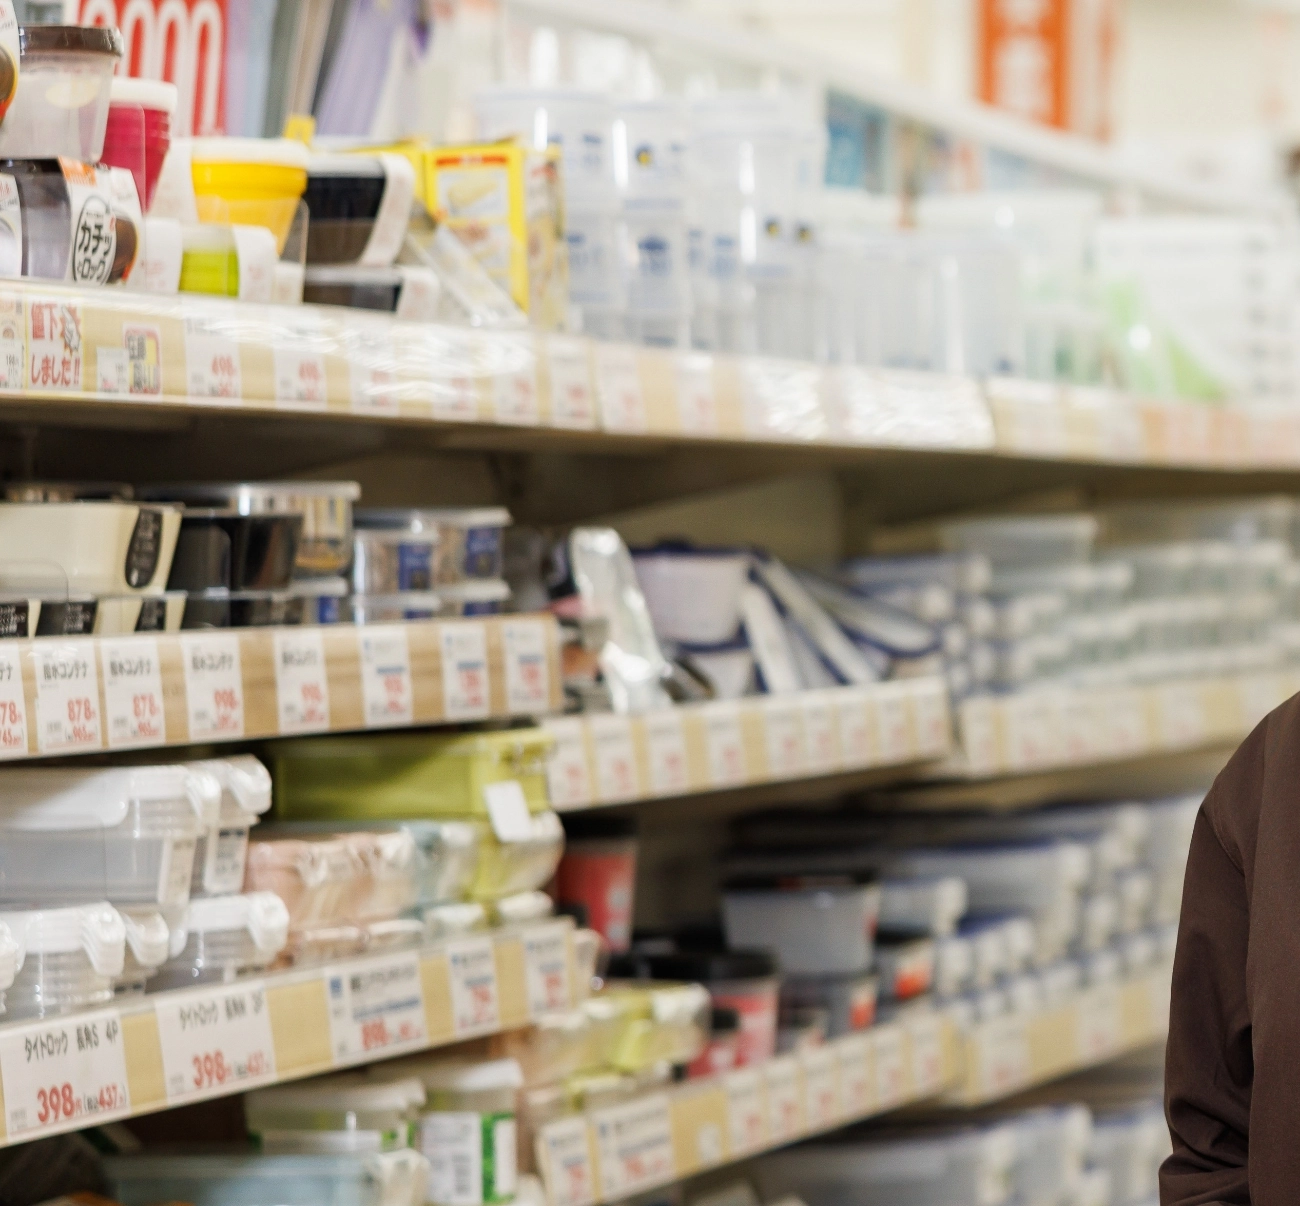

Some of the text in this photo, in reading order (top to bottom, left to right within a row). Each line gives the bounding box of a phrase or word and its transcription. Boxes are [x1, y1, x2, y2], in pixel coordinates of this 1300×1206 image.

[78, 220, 113, 257] カチッ
[25, 1029, 68, 1063] タイトロック
